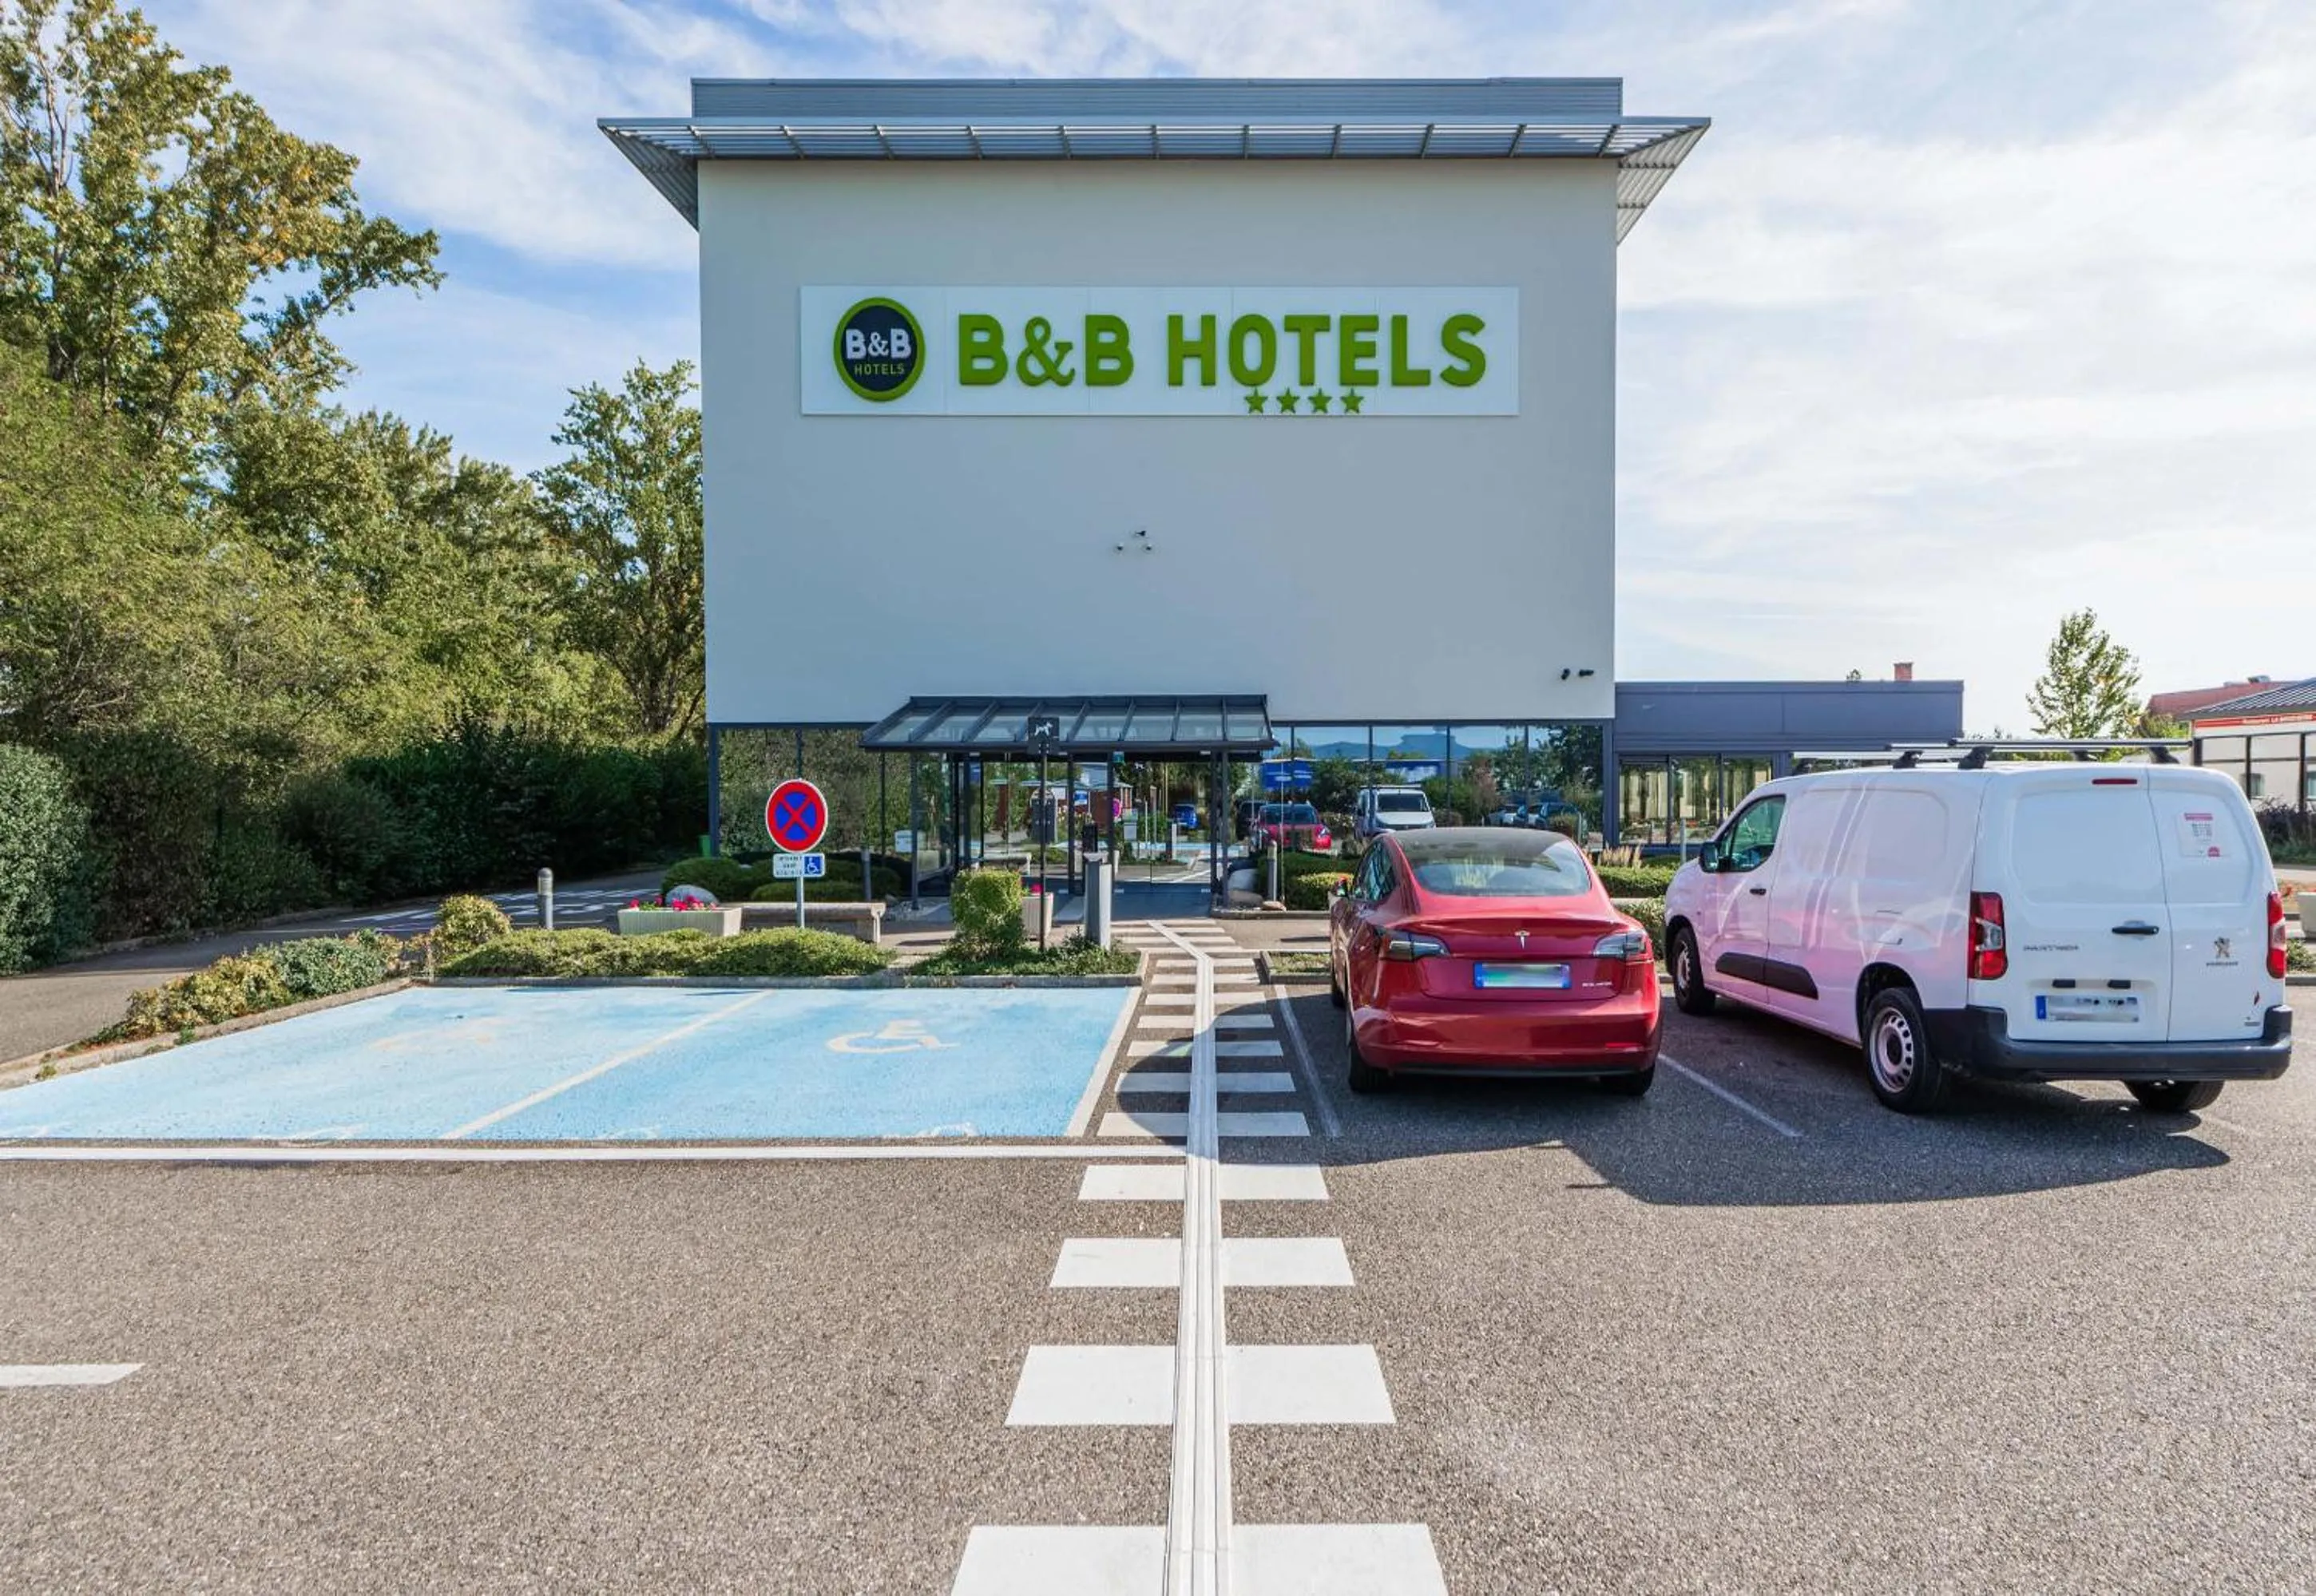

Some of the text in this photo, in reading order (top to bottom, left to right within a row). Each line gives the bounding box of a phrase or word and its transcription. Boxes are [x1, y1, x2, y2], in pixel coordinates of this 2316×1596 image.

[846, 327, 911, 359] B&B
[959, 314, 1486, 386] B&B HOTELS
[854, 362, 905, 377] HOTELS
